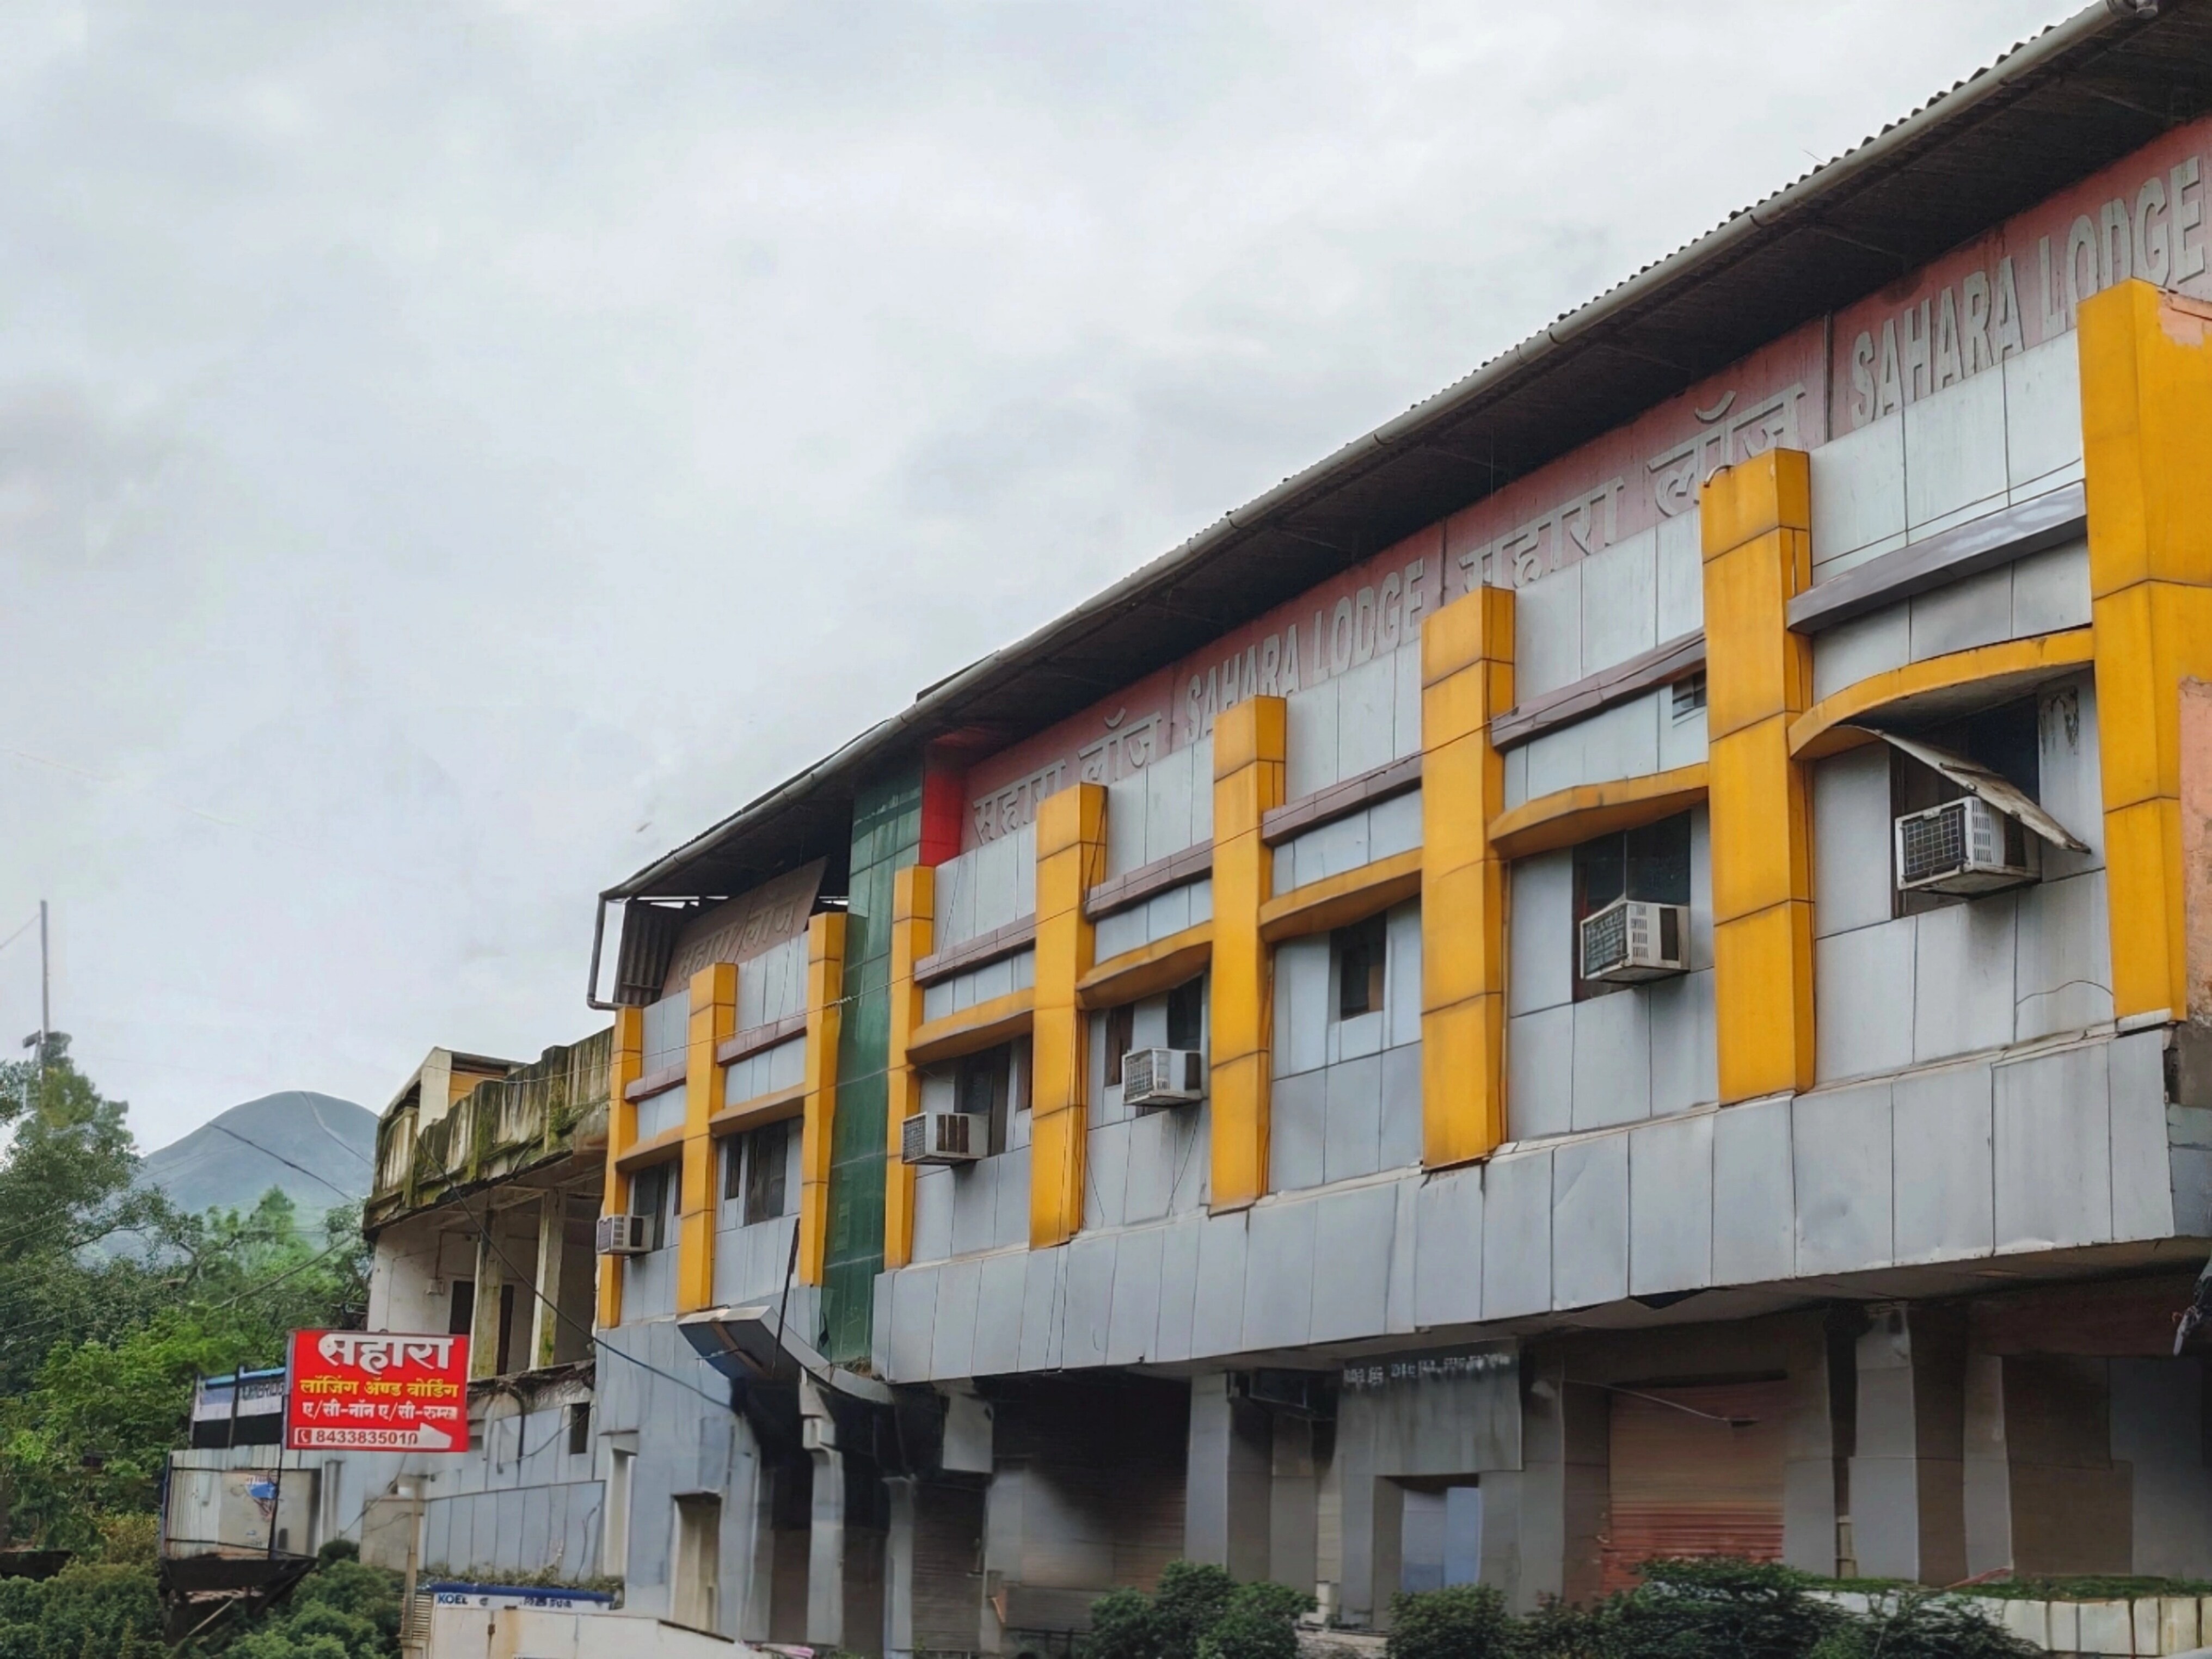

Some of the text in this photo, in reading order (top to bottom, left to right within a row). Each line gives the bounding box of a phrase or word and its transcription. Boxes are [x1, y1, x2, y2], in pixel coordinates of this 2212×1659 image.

[1851, 156, 2205, 430] SAHARA LODGE
[1459, 384, 1805, 593] सहारा लॉज
[1185, 558, 1424, 741] SAHARA LODGE
[973, 708, 1163, 845] सहारा लॉज
[299, 1374, 359, 1397] लॉजिंग
[318, 1333, 454, 1375] सहारा
[316, 1429, 419, 1446] 8433835010
